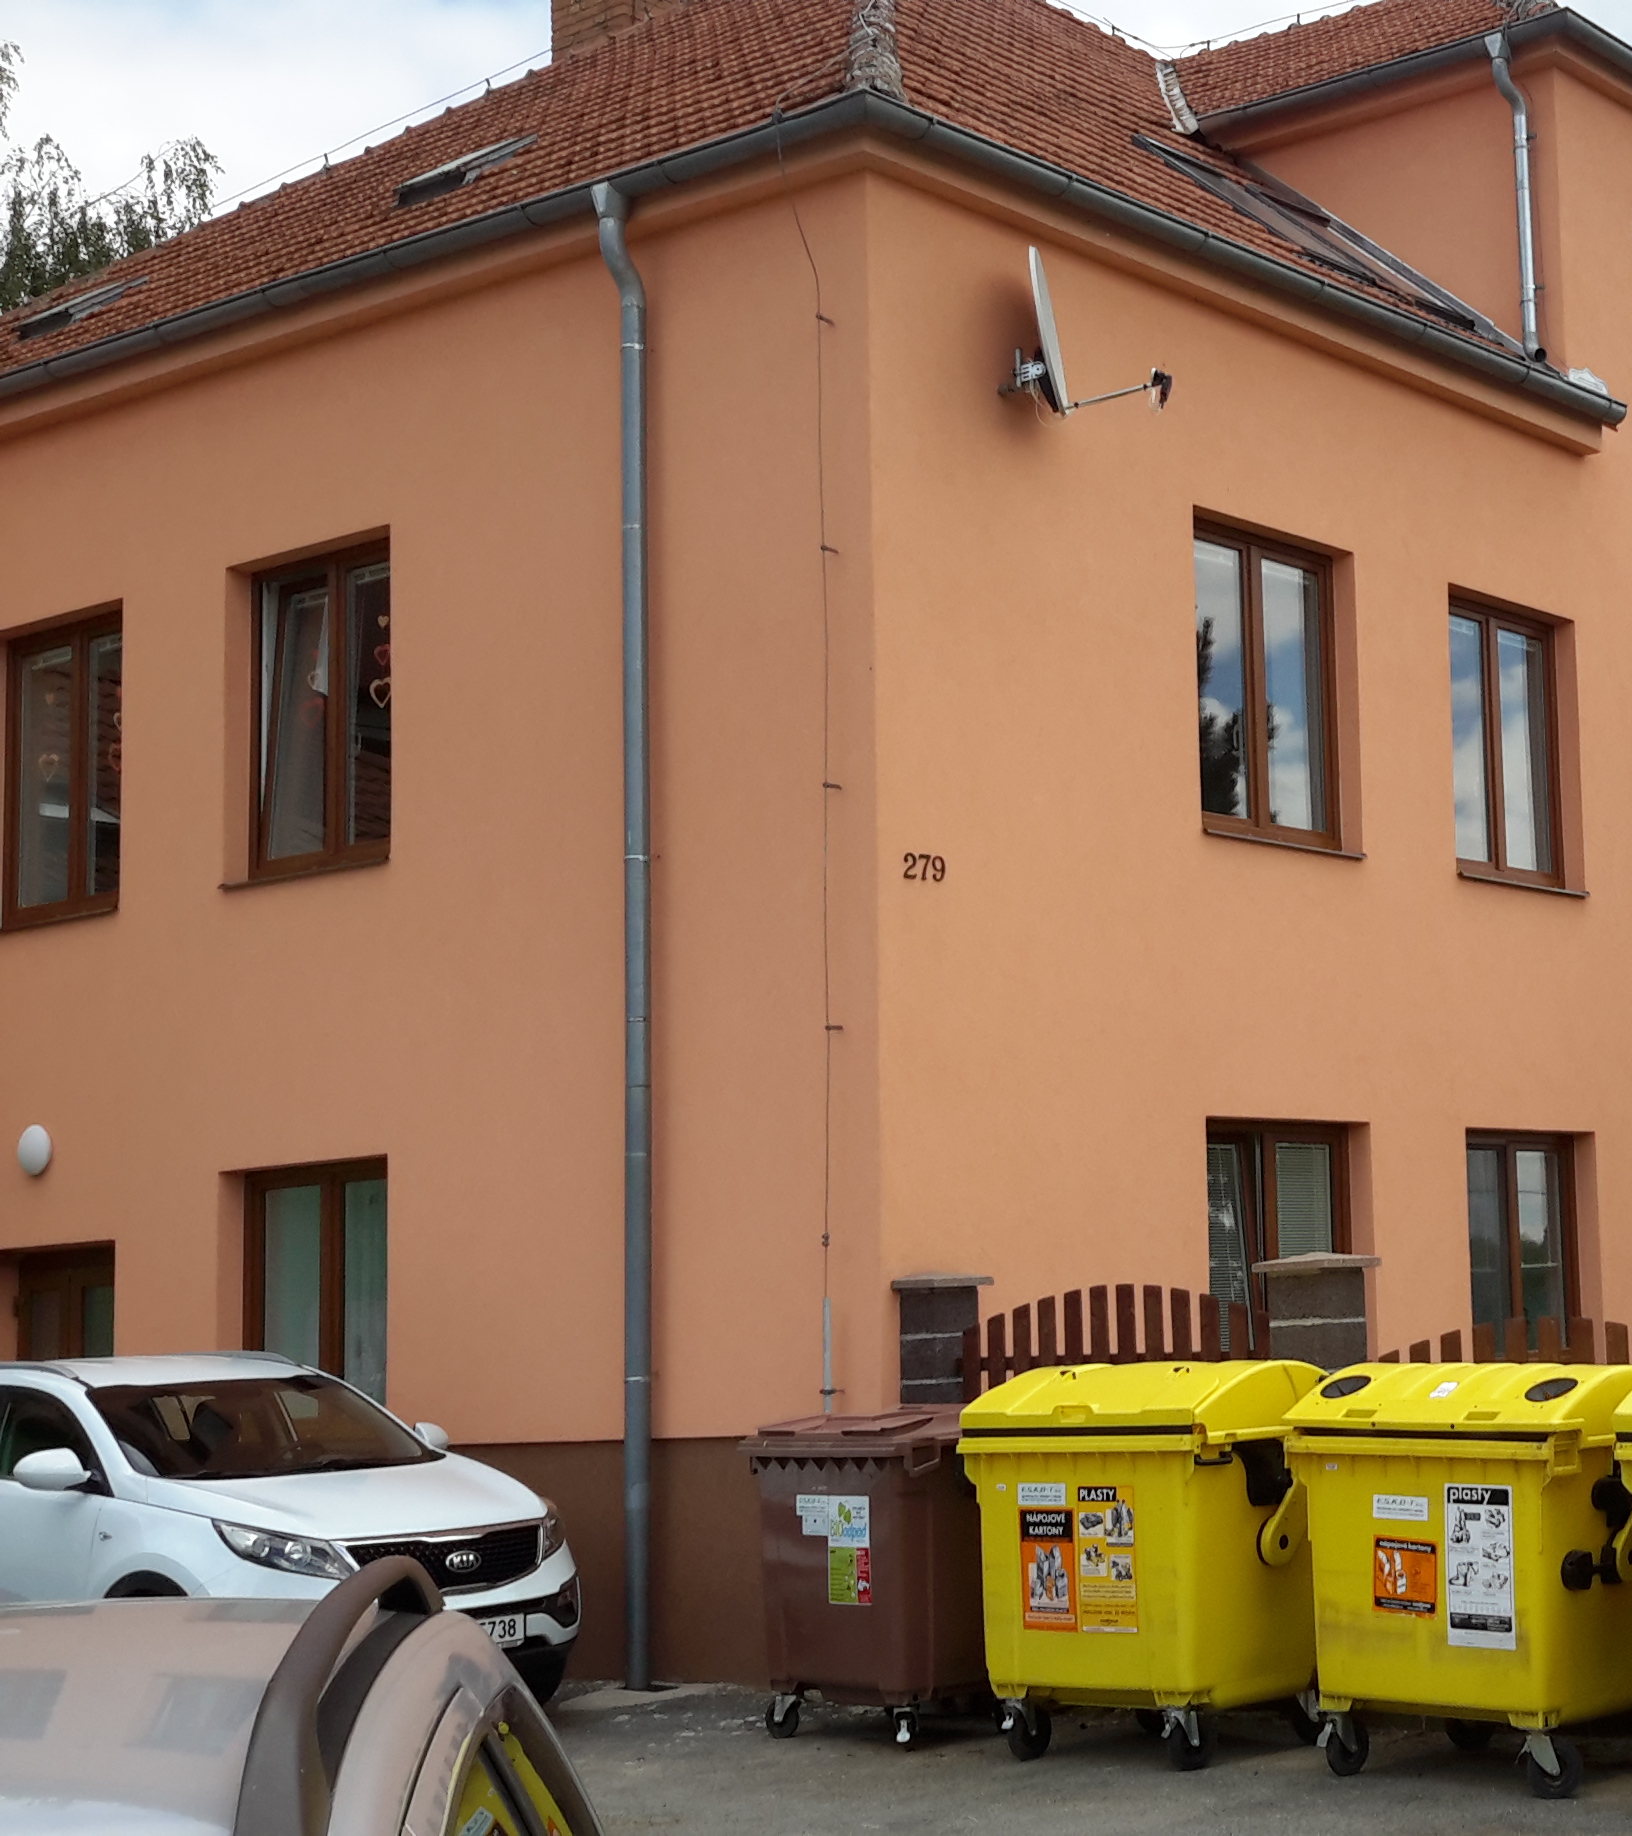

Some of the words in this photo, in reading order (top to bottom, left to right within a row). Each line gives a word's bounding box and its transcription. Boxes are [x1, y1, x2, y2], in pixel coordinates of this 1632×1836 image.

[903, 852, 946, 882] 279
[1079, 1488, 1115, 1501] PLASTY
[1449, 1486, 1492, 1506] plasty
[1025, 1511, 1066, 1524] NÁPOJOVÉ
[1028, 1525, 1064, 1536] KARTONY
[452, 1553, 478, 1569] KIA
